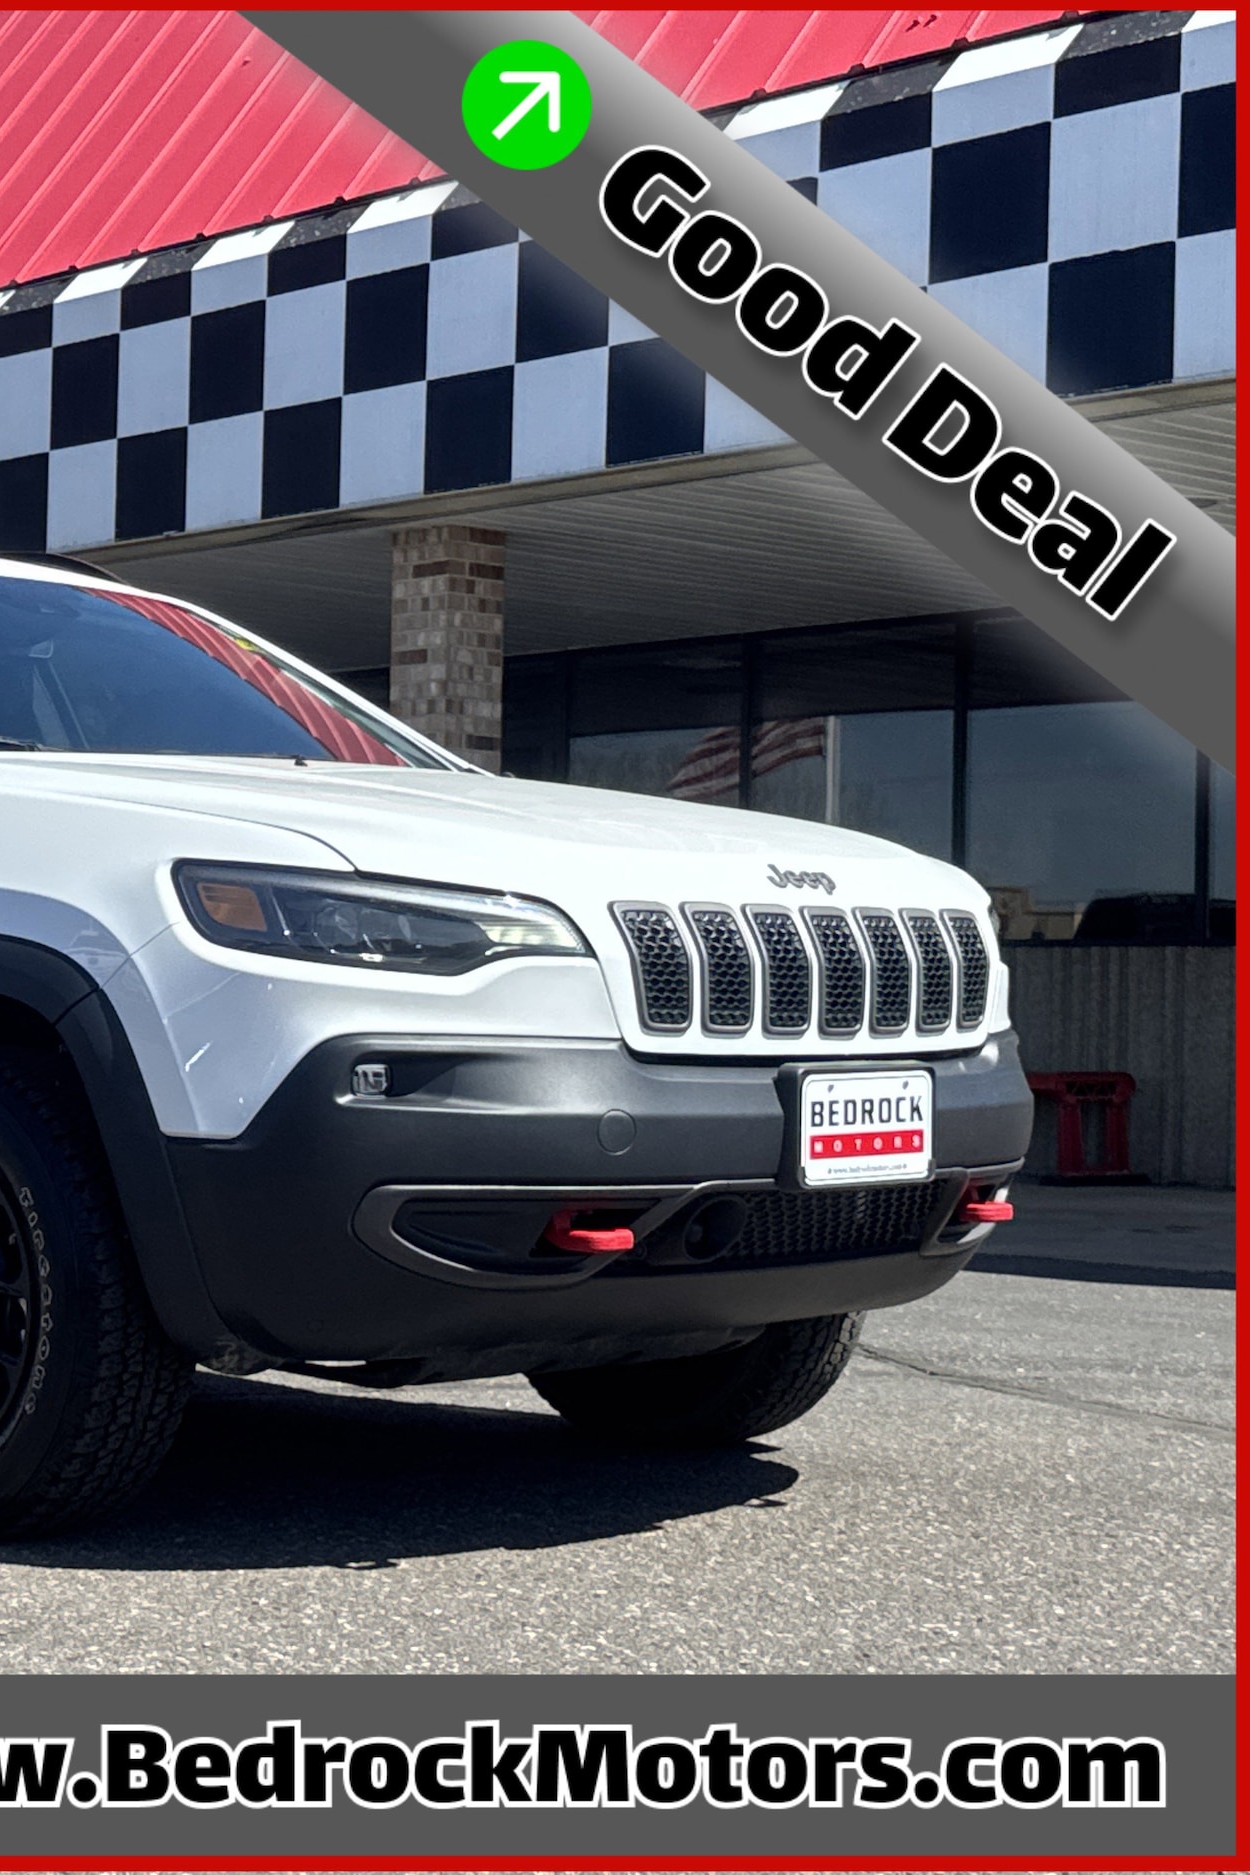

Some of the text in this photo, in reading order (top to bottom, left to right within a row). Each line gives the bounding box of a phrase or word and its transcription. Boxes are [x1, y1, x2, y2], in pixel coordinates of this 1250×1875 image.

[766, 863, 836, 896] Jeep
[810, 1096, 923, 1127] BEDROCK
[813, 1135, 921, 1153] MOTORS
